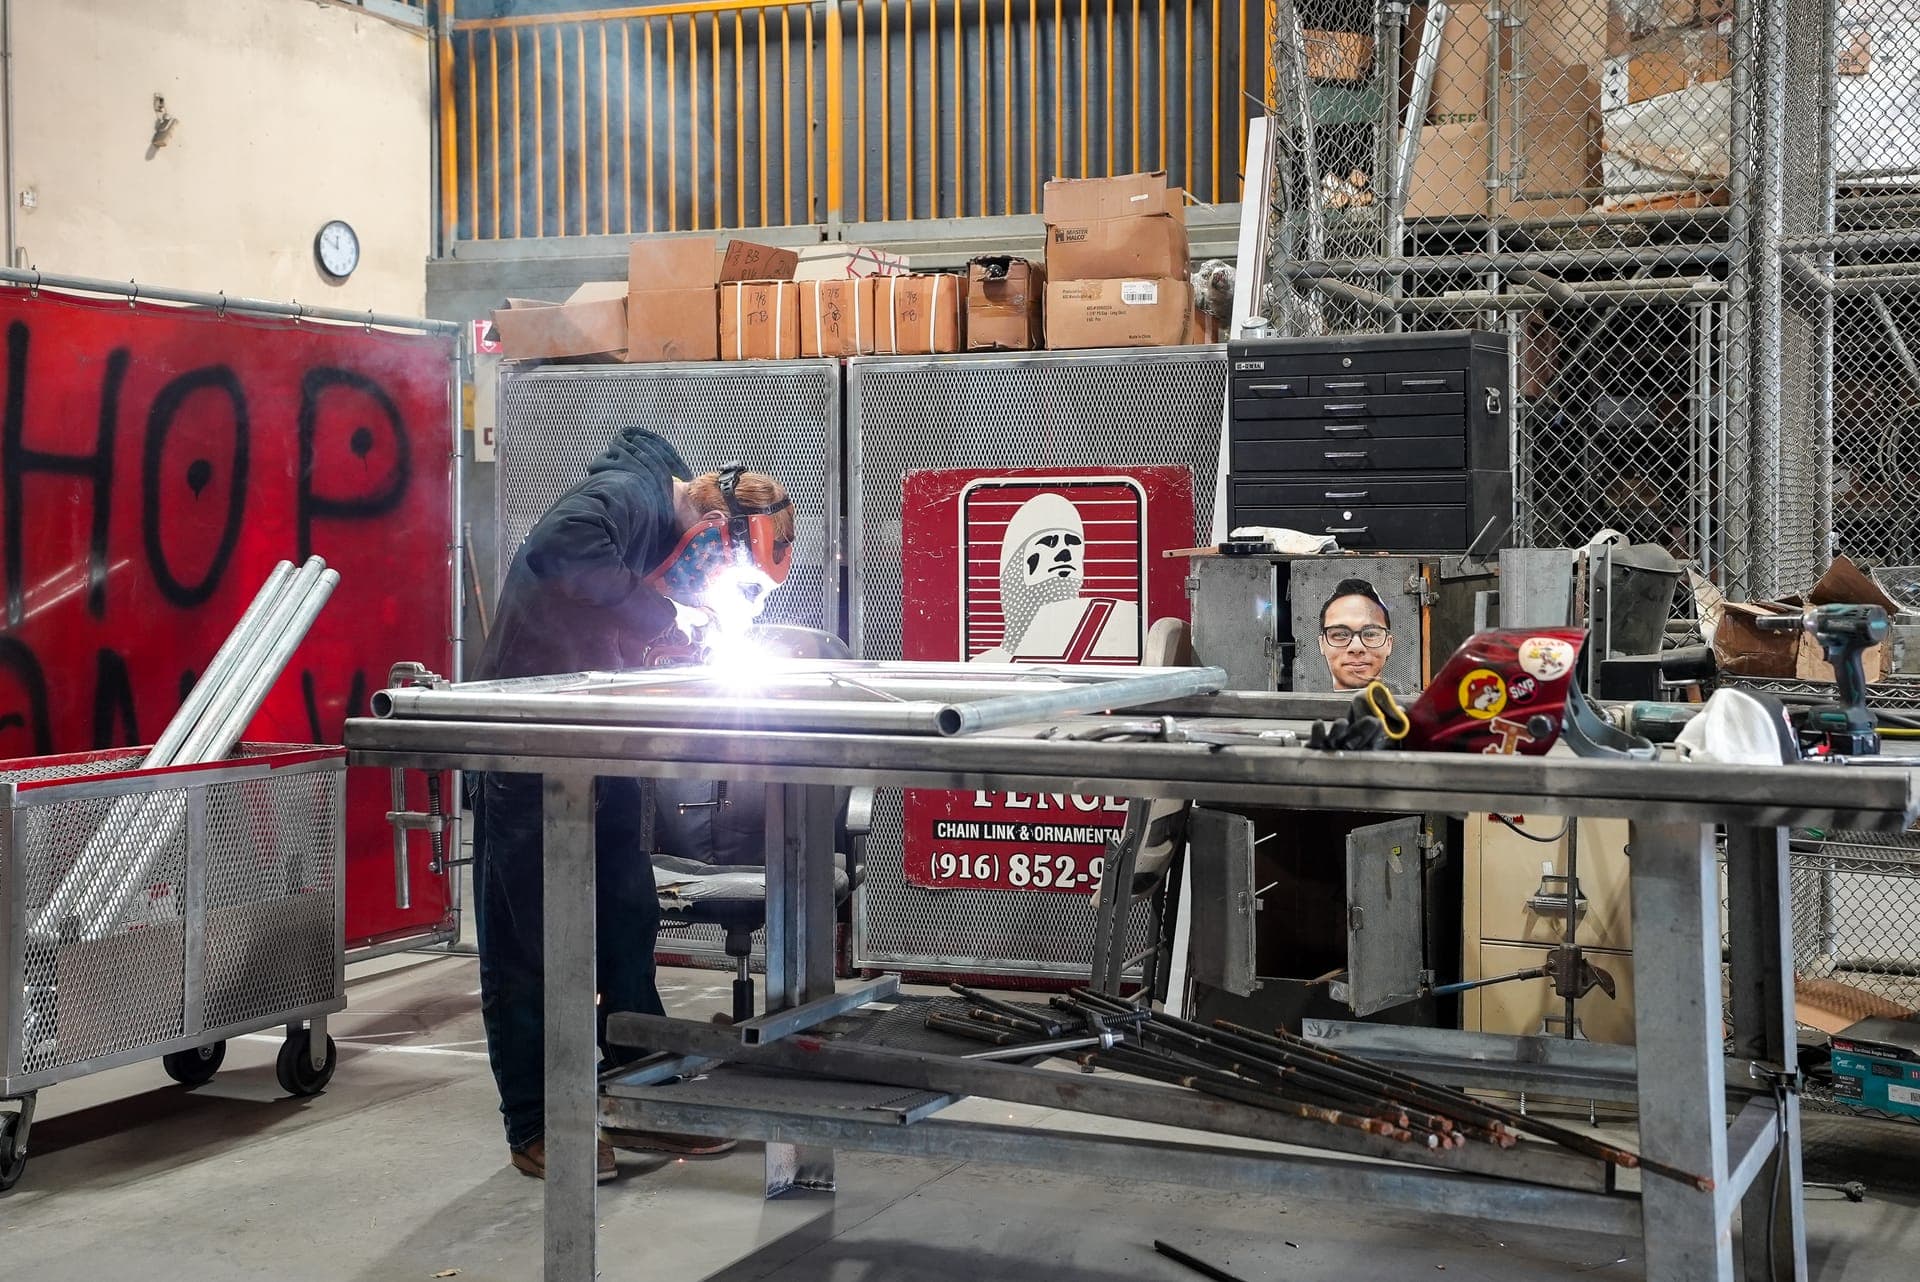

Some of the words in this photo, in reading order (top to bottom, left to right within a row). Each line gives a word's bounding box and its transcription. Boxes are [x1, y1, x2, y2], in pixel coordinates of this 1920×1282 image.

[937, 822, 979, 840] CHAIN
[983, 825, 1015, 840] LINK
[1019, 825, 1030, 840] &
[931, 852, 999, 882] (916)
